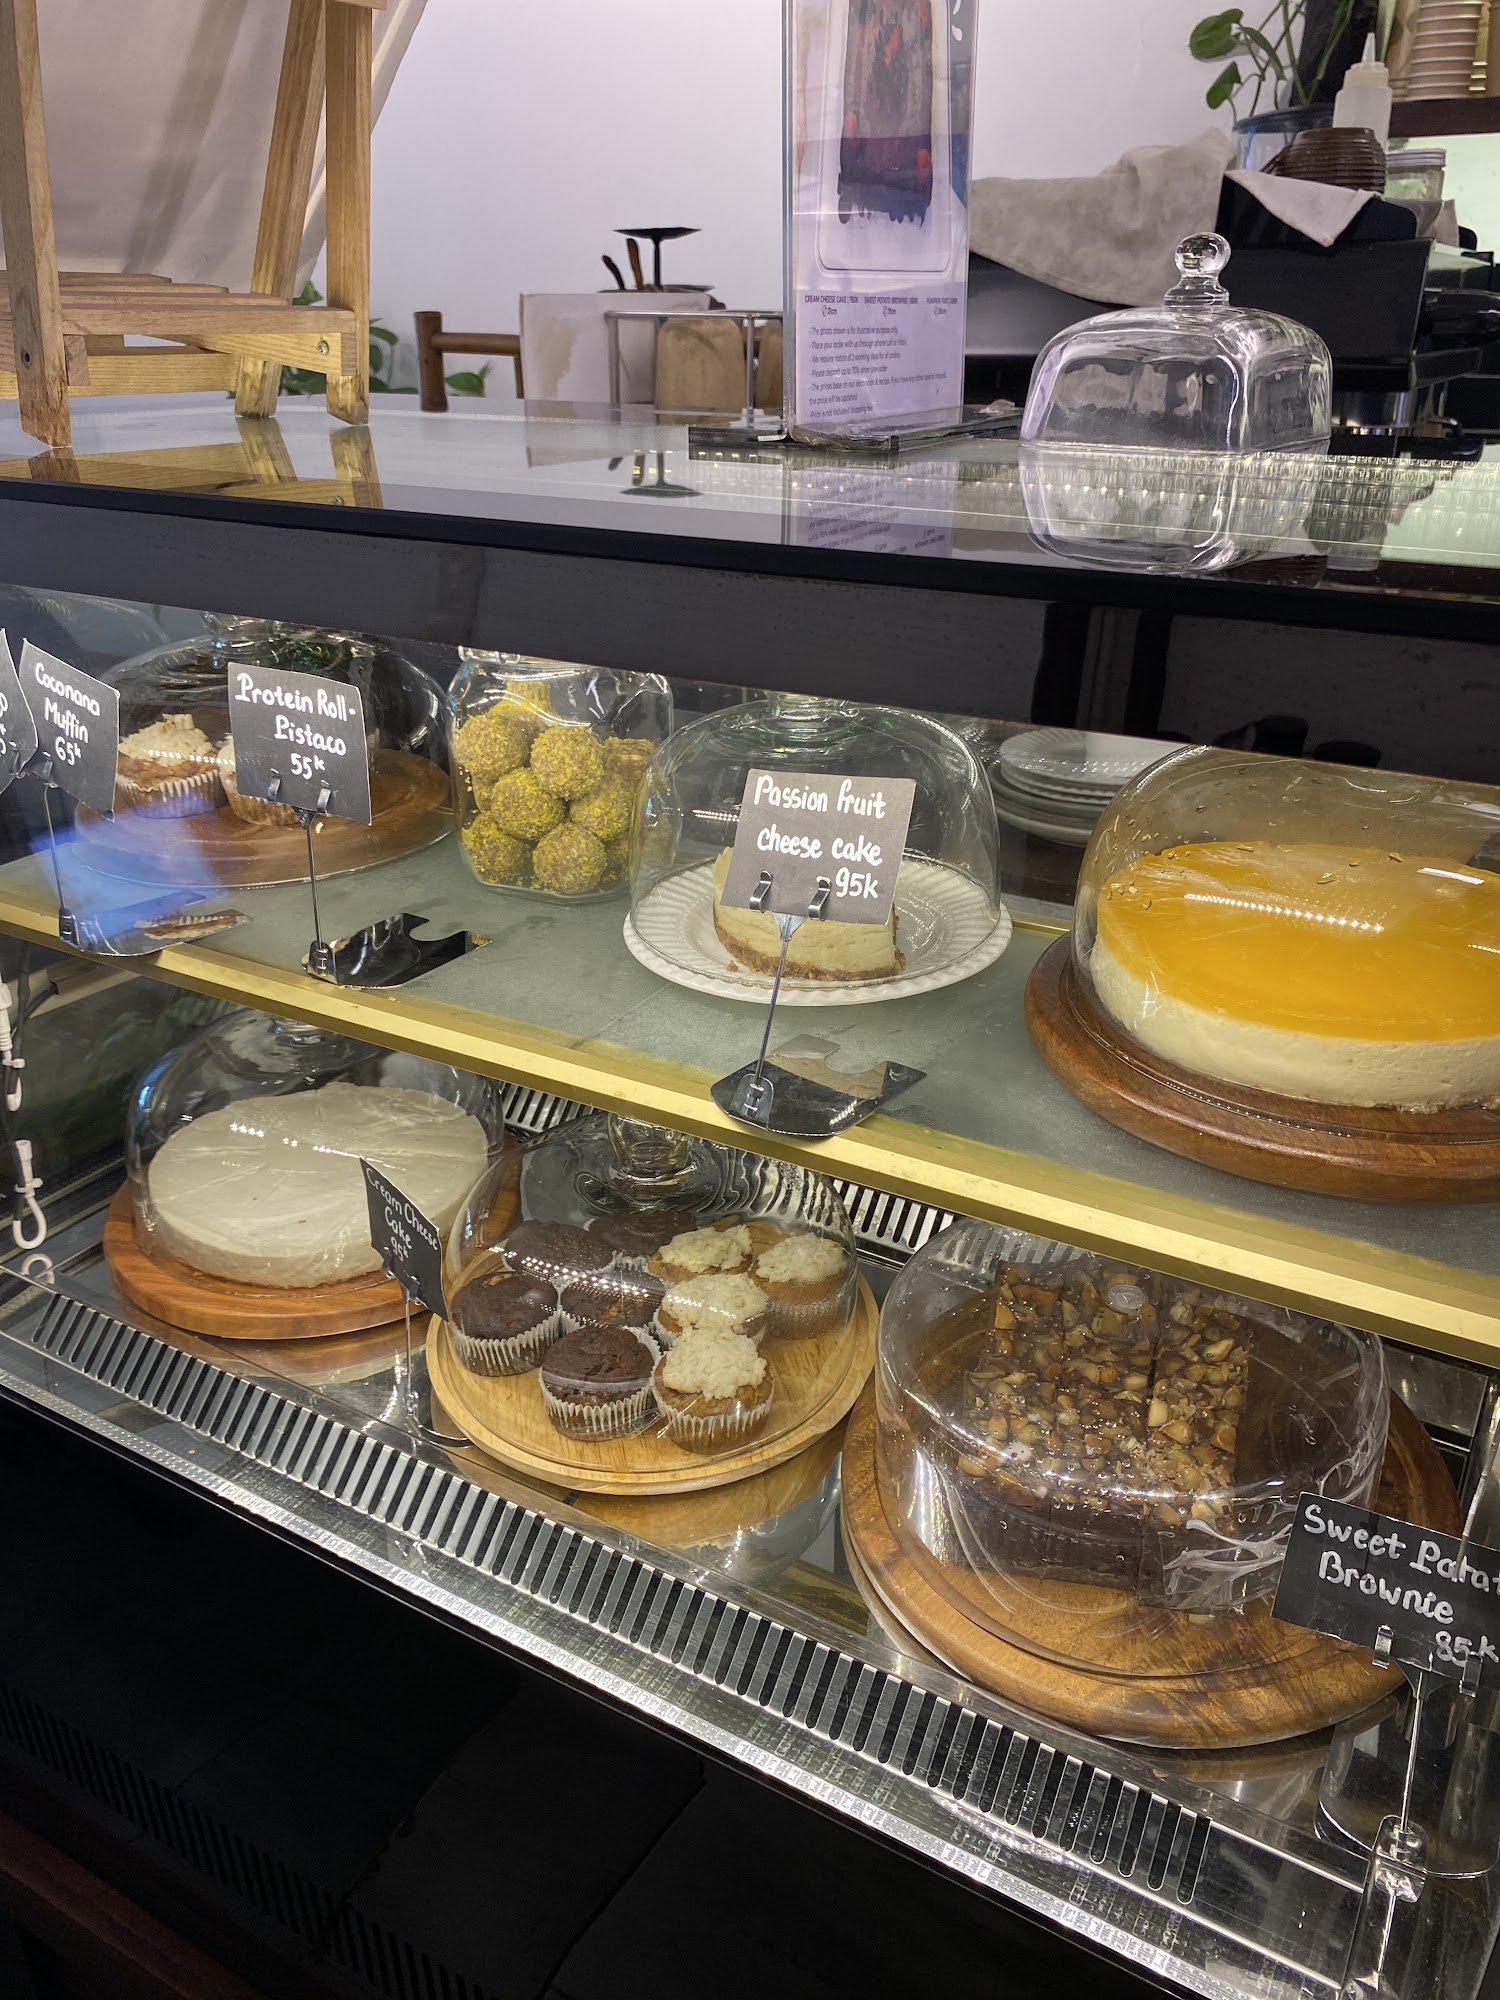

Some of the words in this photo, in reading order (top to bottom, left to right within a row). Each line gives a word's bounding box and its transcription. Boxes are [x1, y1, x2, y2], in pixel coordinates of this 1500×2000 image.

[35, 662, 101, 717] Coconana
[235, 672, 314, 714] Protein
[44, 696, 89, 744] Muffin
[274, 714, 347, 756] Pistaco
[55, 736, 82, 766] 65k
[290, 752, 326, 780] 55k
[753, 774, 829, 813] Passion
[835, 866, 879, 899] 95k
[366, 1167, 402, 1215] Cream
[404, 1202, 438, 1251] Cheese
[384, 1206, 412, 1250] Cake
[1303, 1503, 1406, 1559] Sweet
[1318, 1550, 1454, 1624] Brownie
